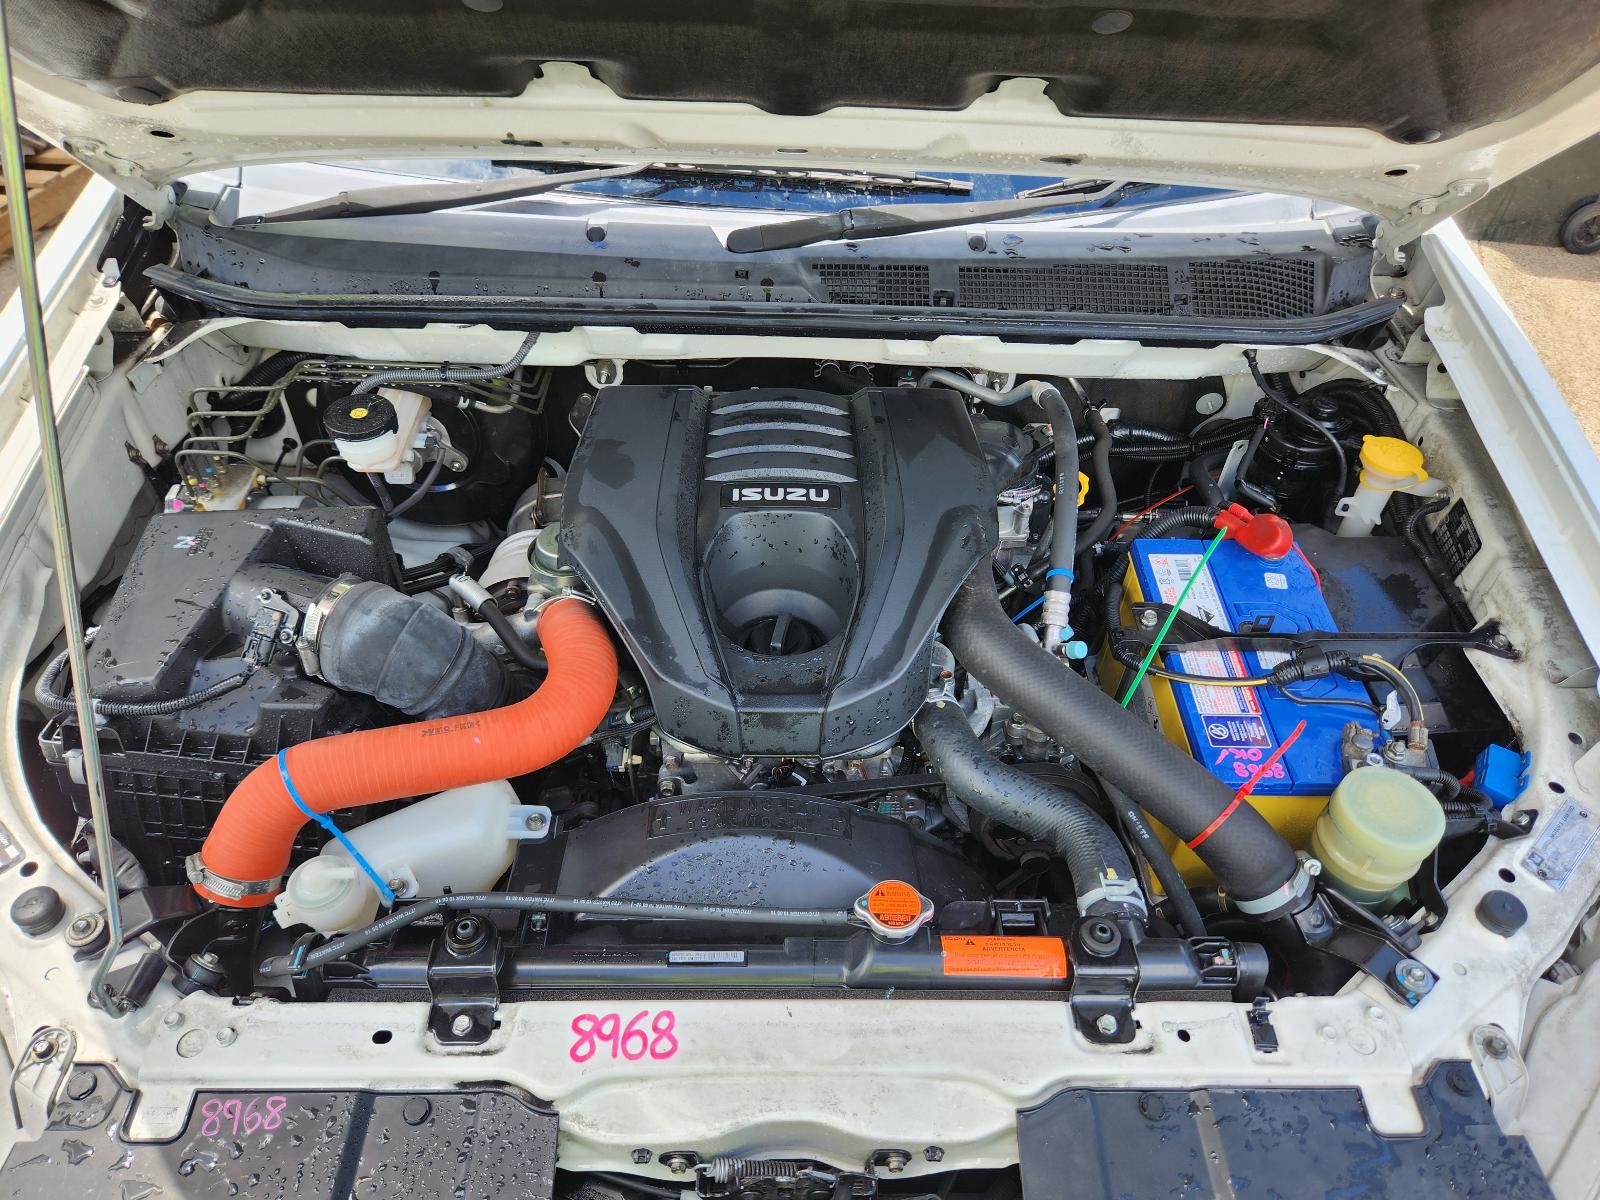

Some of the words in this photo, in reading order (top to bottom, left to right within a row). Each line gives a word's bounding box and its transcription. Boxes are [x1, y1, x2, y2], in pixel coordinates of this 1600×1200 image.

[732, 487, 830, 502] ISUZU
[385, 912, 404, 926] WATER
[570, 1010, 679, 1063] 8968
[201, 1095, 287, 1137] 8968
